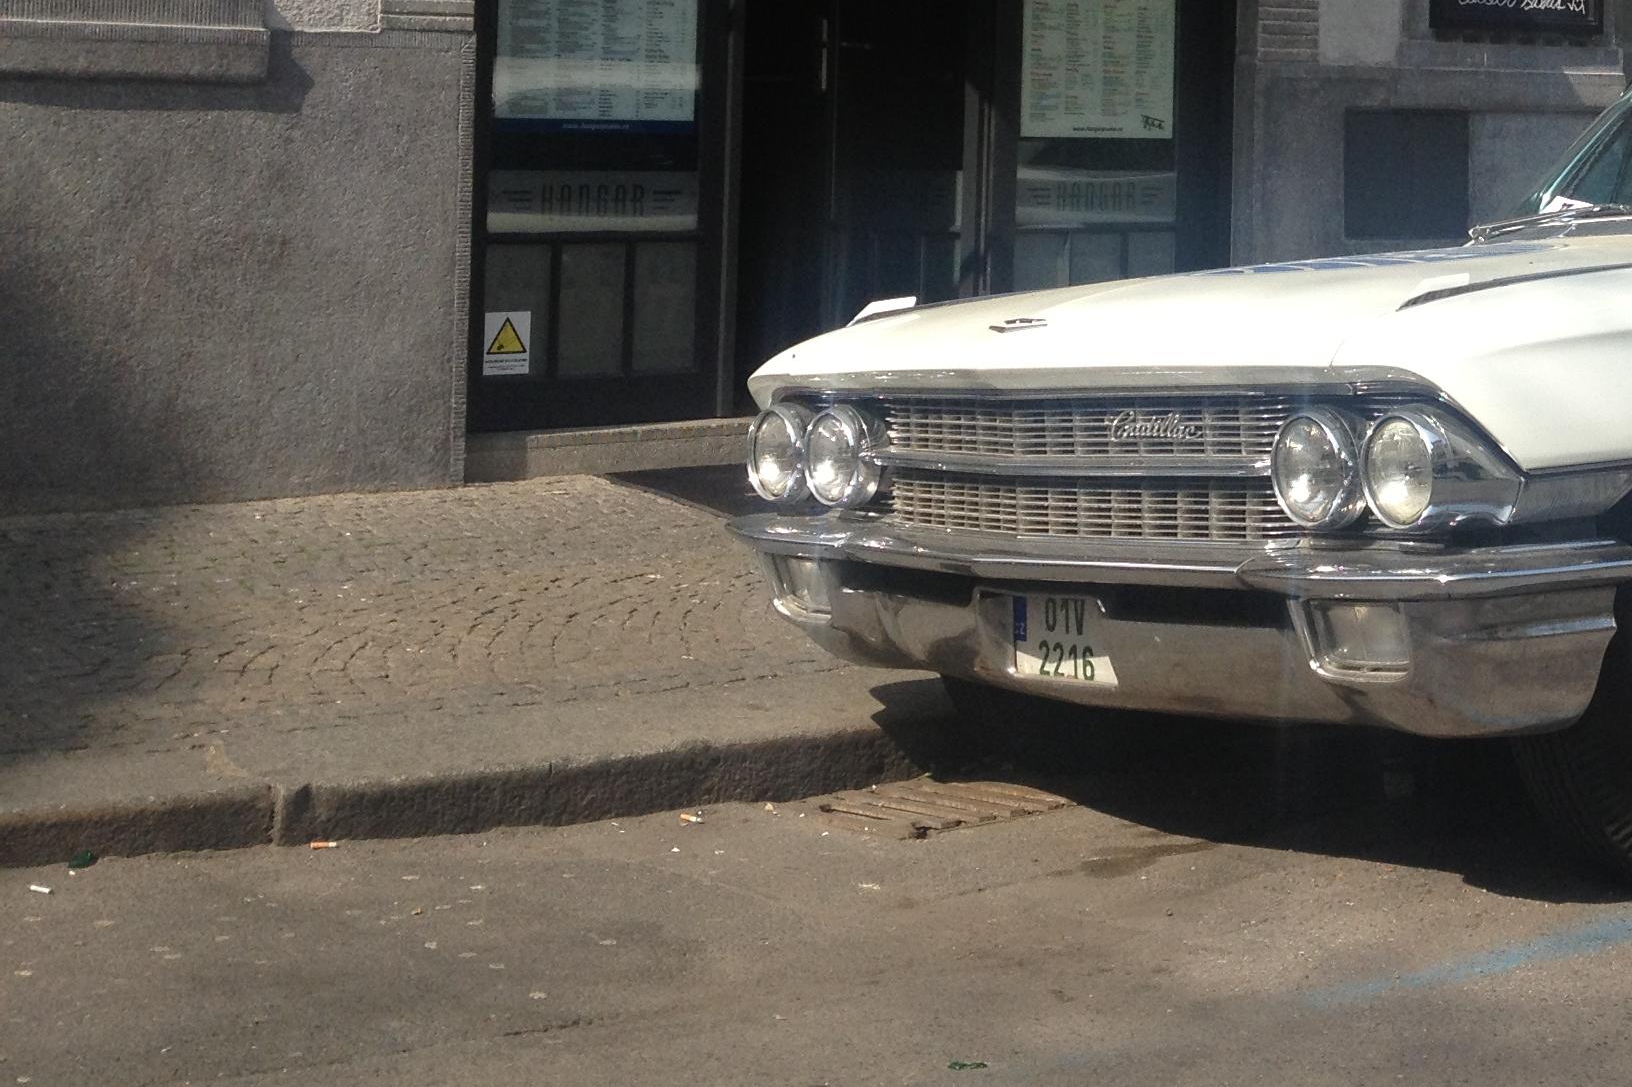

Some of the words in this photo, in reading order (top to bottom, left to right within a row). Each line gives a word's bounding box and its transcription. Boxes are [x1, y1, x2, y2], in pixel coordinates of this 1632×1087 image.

[1104, 411, 1203, 441] Cadillac
[1045, 597, 1086, 636] 01V
[1038, 639, 1095, 681] 2216
